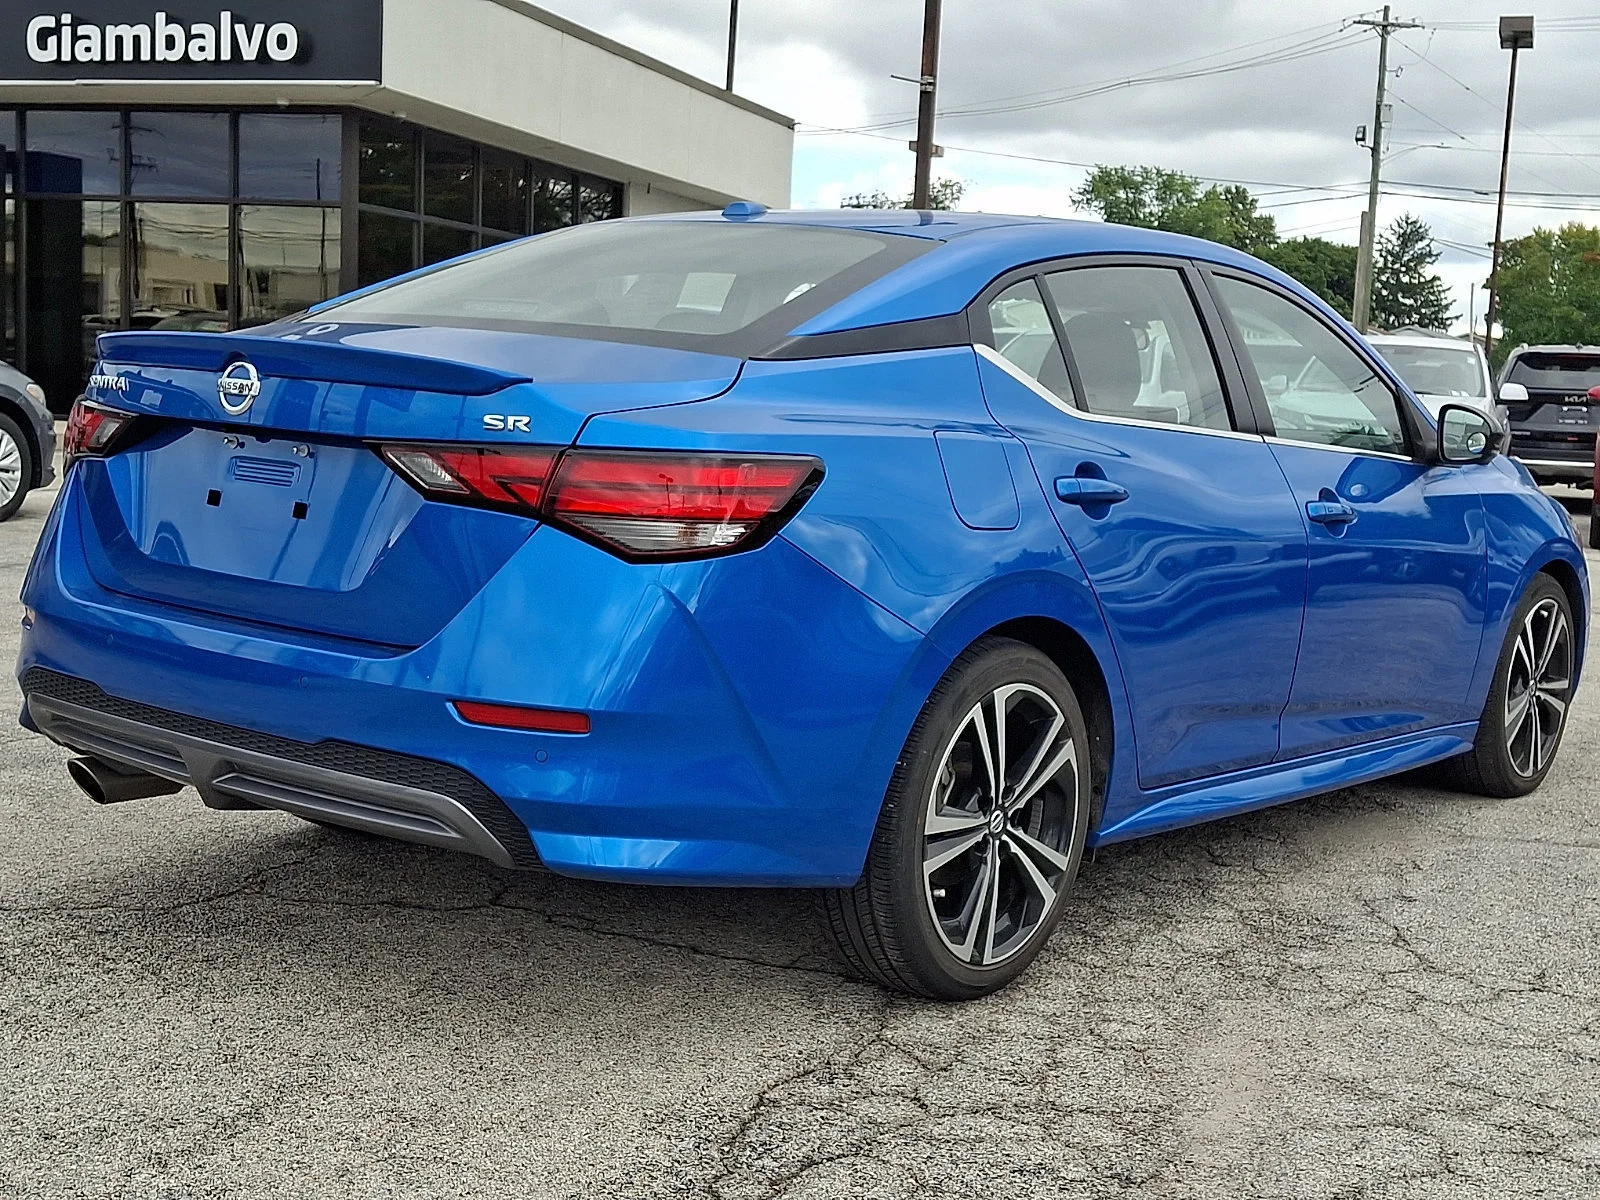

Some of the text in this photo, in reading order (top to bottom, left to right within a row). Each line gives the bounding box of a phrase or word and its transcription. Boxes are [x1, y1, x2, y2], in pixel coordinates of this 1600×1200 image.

[26, 11, 299, 63] Giambalvo
[218, 380, 254, 394] NISSAN
[483, 414, 532, 433] SR
